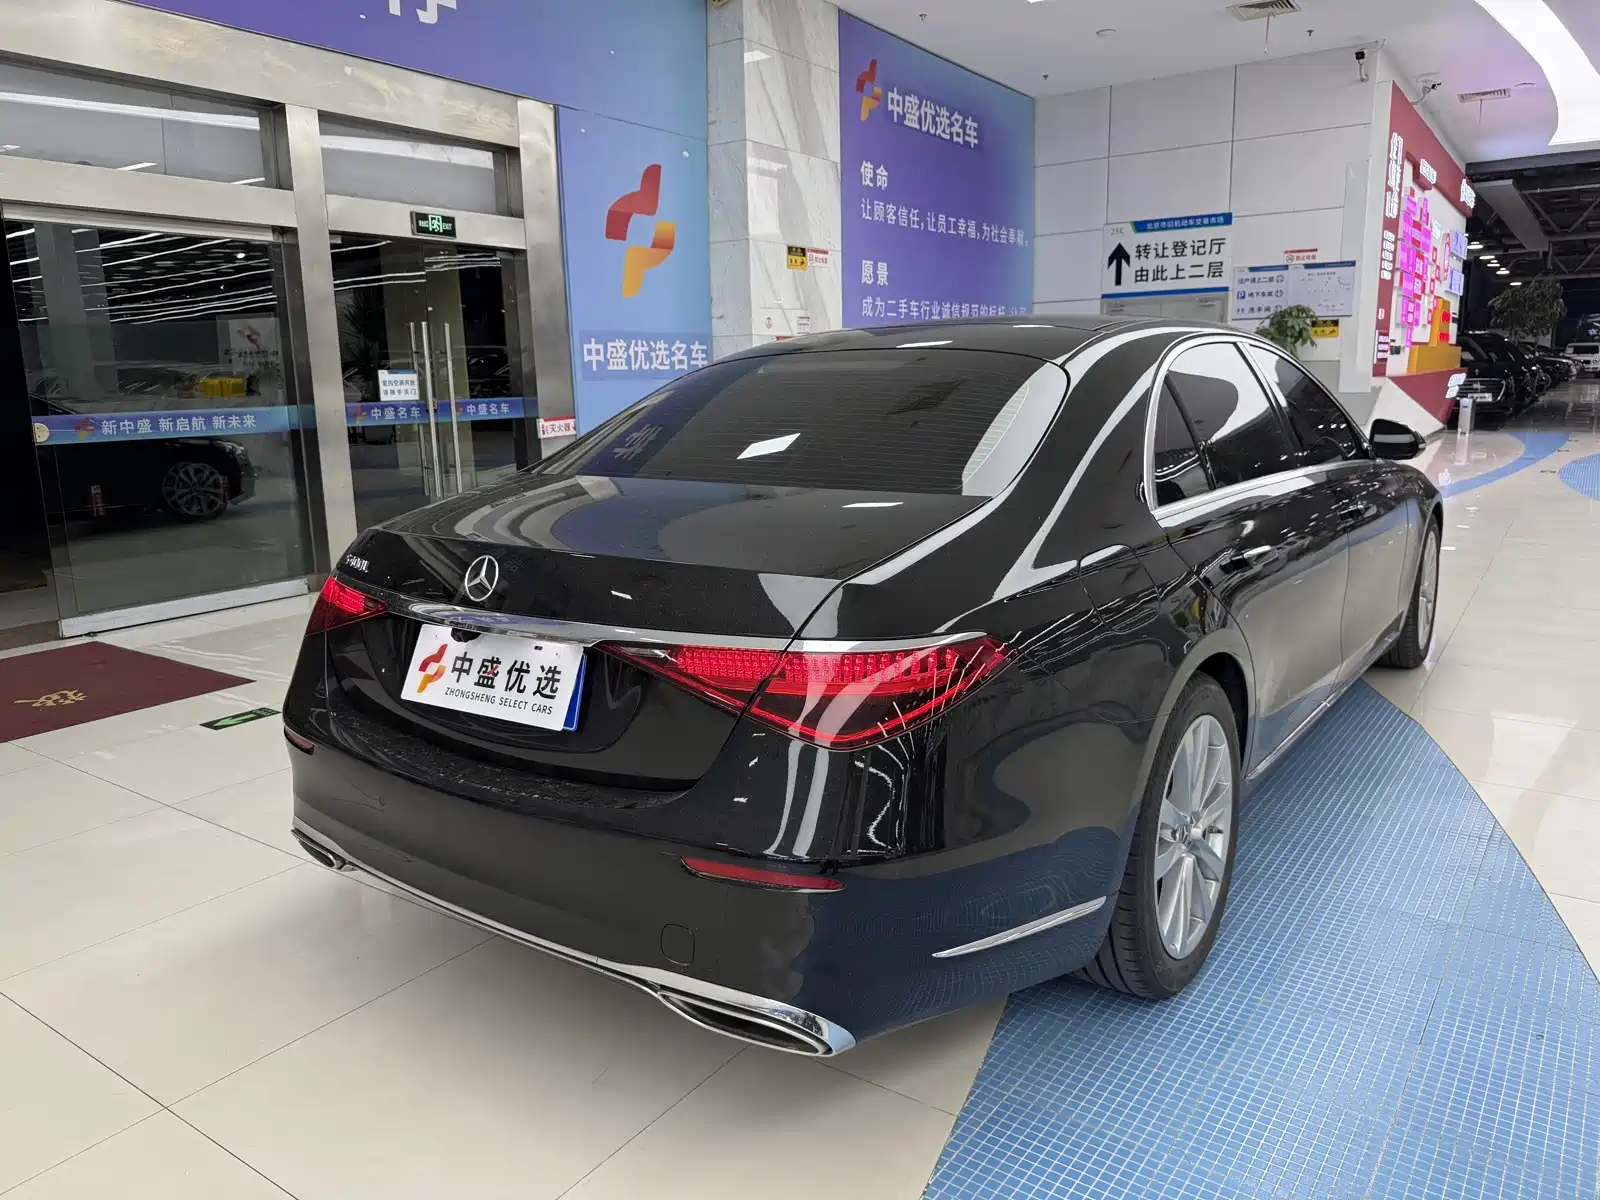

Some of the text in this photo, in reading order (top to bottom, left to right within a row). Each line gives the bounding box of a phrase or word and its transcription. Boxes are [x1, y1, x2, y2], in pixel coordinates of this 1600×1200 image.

[887, 87, 979, 149] 中盛优选名车
[860, 160, 888, 191] 使命
[1135, 237, 1227, 261] 转让登记厅
[861, 259, 889, 286] 愿景
[1134, 261, 1224, 283] 由此上二层
[583, 338, 708, 371] 中盛优选名车
[370, 406, 421, 421] 中盛名车
[466, 403, 510, 416] 中盛名车
[100, 414, 257, 435] 新中盛 新启航 新未来
[549, 422, 571, 433] 灭火器
[450, 651, 562, 700] 中盛优选
[444, 687, 553, 715] ZHONGSHENG SELECT CARS
